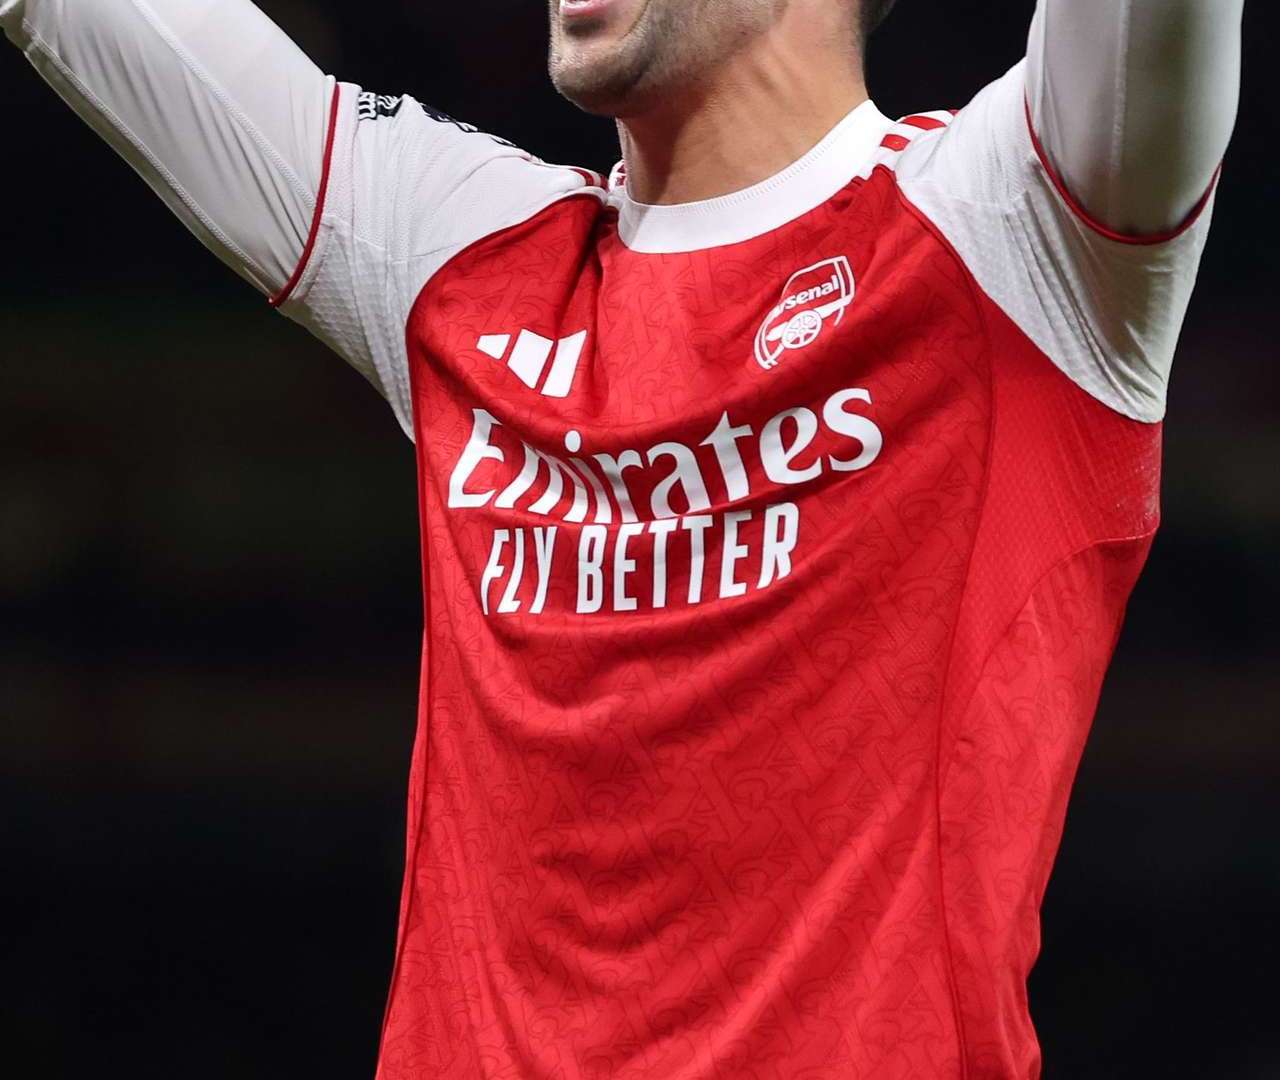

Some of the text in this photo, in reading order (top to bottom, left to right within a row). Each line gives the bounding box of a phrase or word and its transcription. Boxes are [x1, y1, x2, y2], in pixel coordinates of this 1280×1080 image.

[447, 387, 883, 525] Emirates
[480, 502, 799, 616] FLY BETTER
